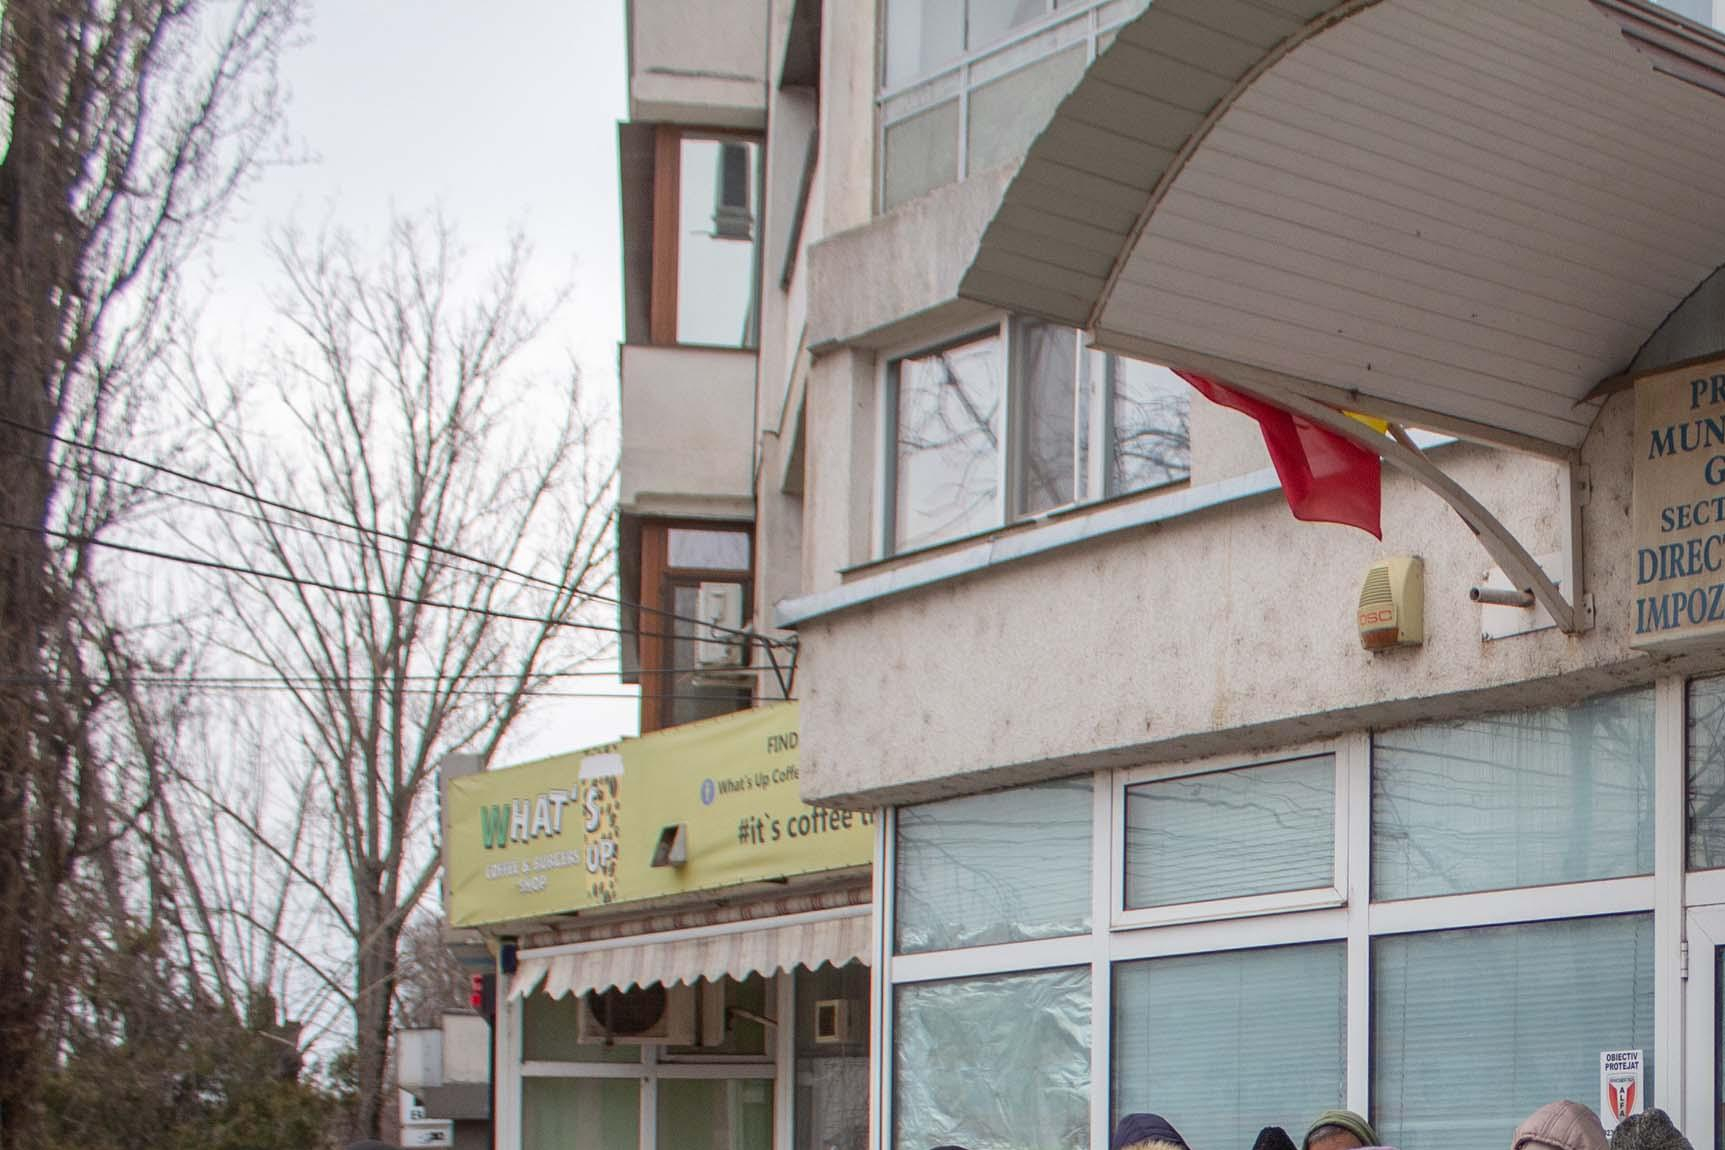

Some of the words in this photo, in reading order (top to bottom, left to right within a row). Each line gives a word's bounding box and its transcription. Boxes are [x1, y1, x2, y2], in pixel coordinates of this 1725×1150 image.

[767, 731, 799, 754] FIND
[755, 771, 770, 790] Up
[787, 806, 853, 838] coffee
[586, 839, 616, 874] UP
[1605, 1062, 1640, 1071] PROTEJAT
[1606, 1052, 1638, 1062] OBIECTIV
